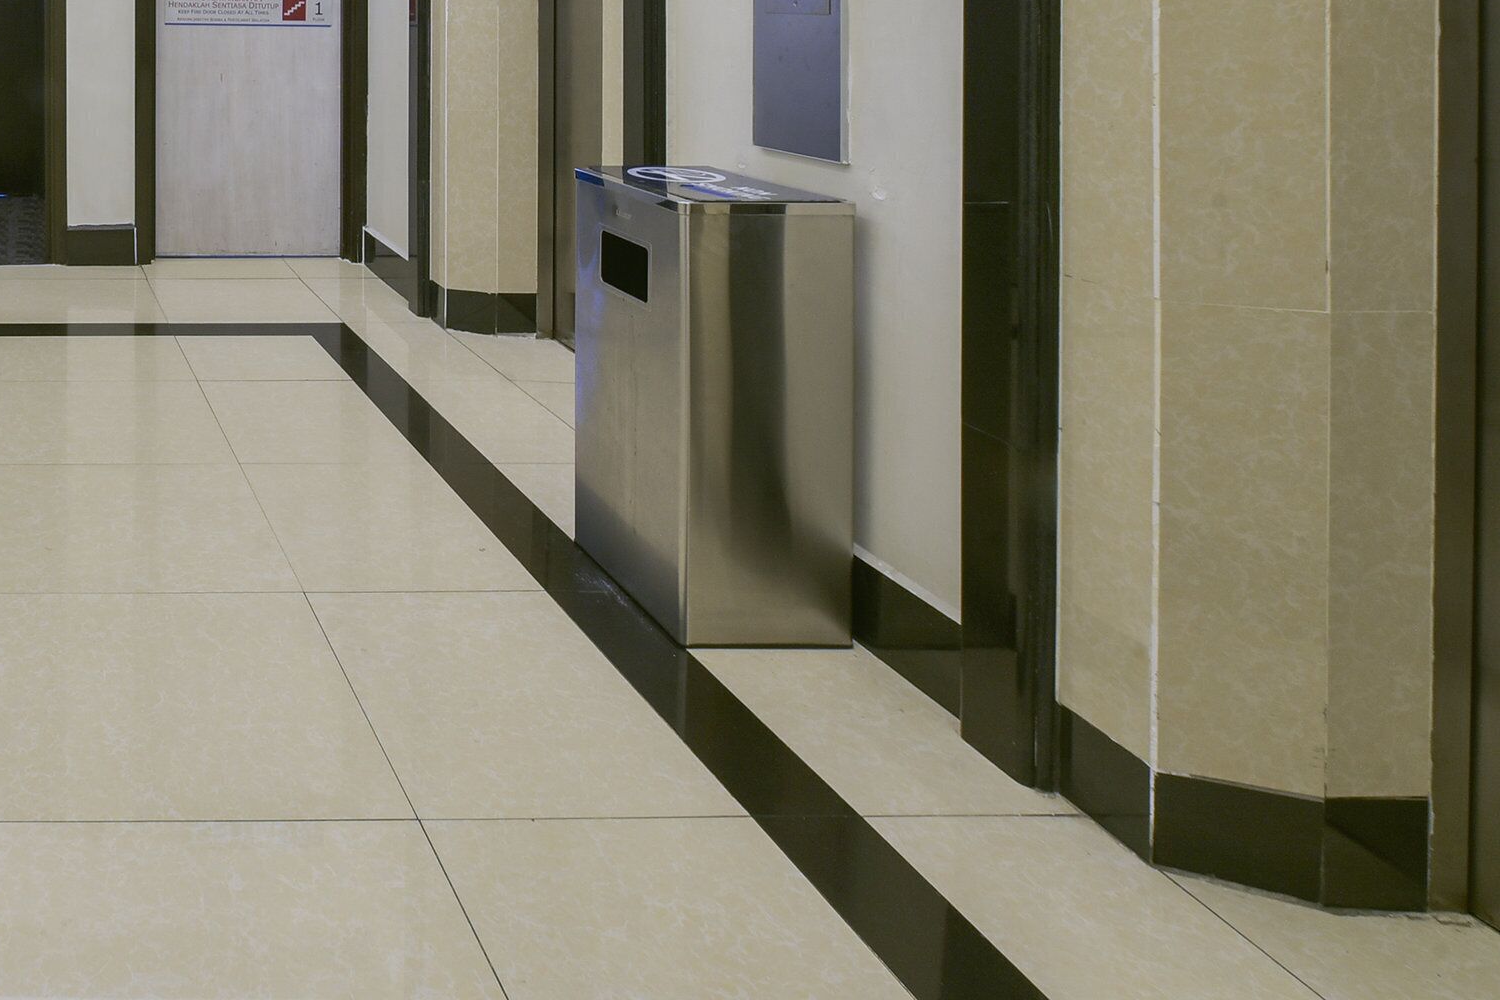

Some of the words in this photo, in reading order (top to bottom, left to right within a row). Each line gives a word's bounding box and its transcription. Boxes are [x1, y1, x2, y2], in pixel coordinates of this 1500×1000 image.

[168, 1, 210, 9] HENDAKLAH
[212, 1, 247, 10] SENTIASA
[248, 2, 279, 10] DITUTUP
[315, 1, 323, 16] 1
